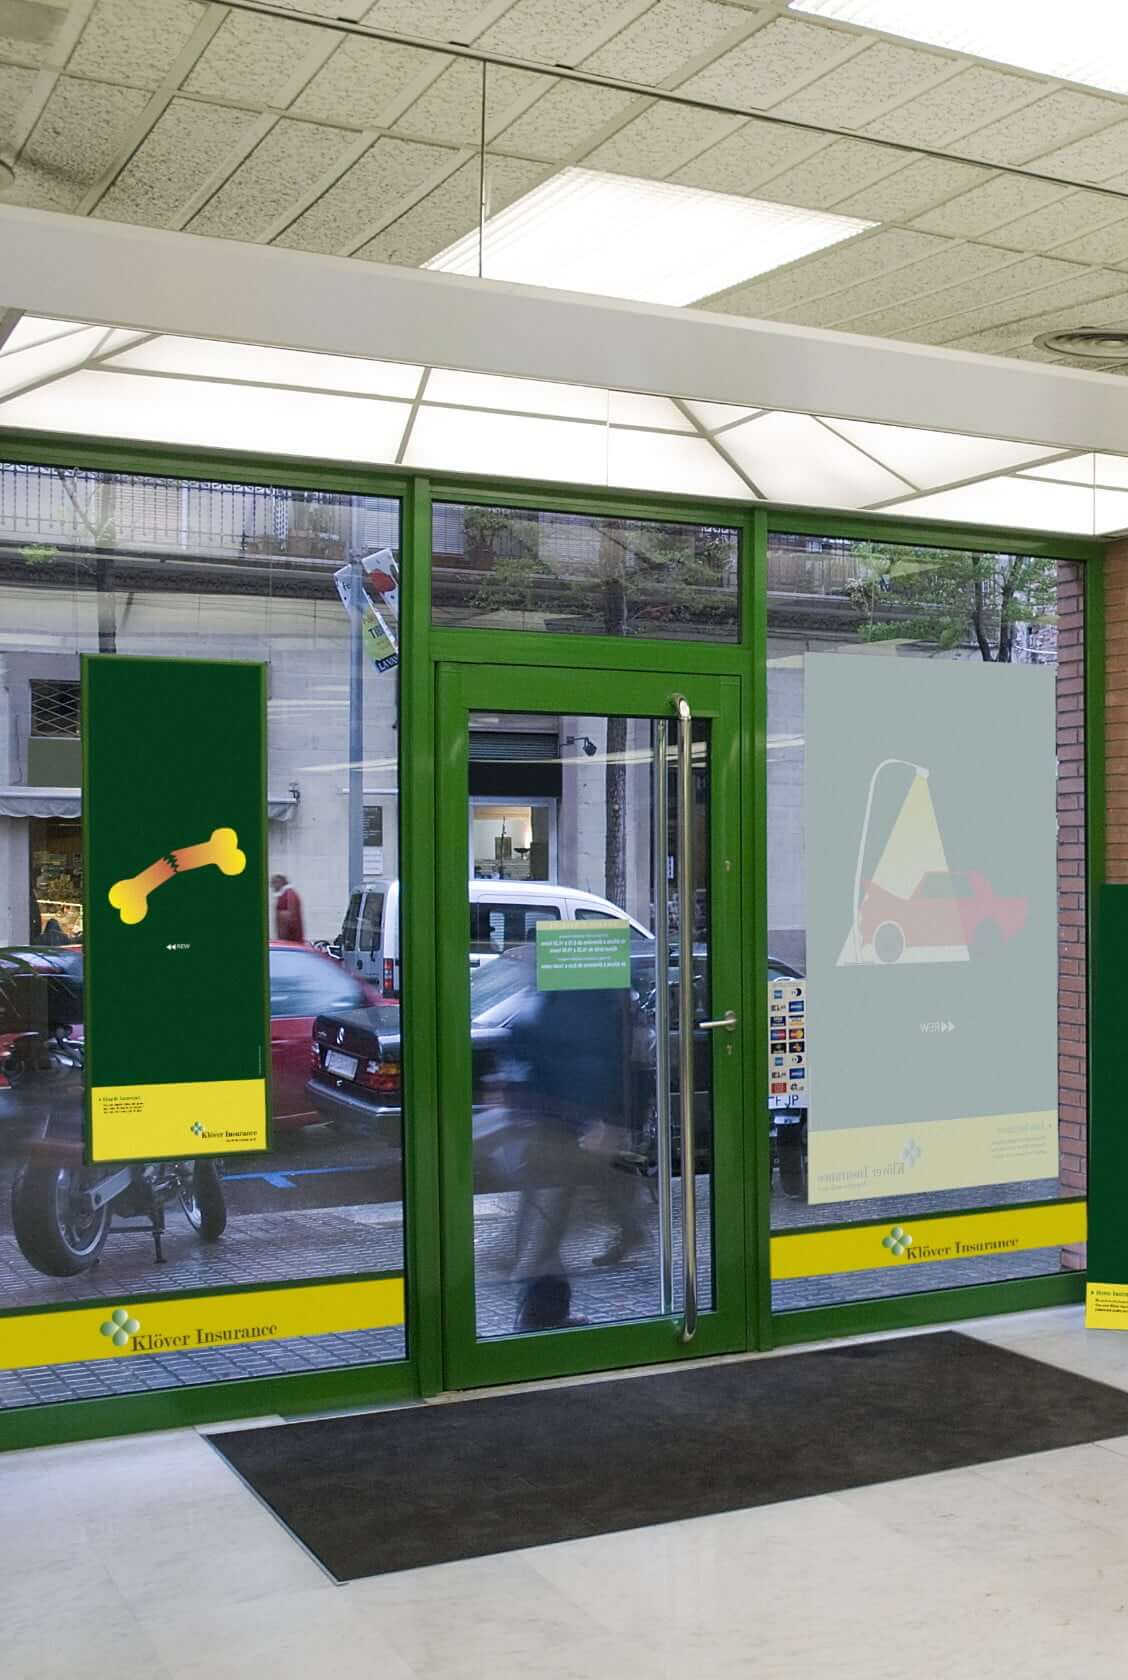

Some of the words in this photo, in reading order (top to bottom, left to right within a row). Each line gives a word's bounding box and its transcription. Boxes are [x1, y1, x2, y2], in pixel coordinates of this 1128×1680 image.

[905, 1244, 952, 1261] Klöver
[954, 1237, 1019, 1255] Insurance
[131, 1332, 191, 1352] Klöver
[194, 1323, 278, 1345] Insurance
